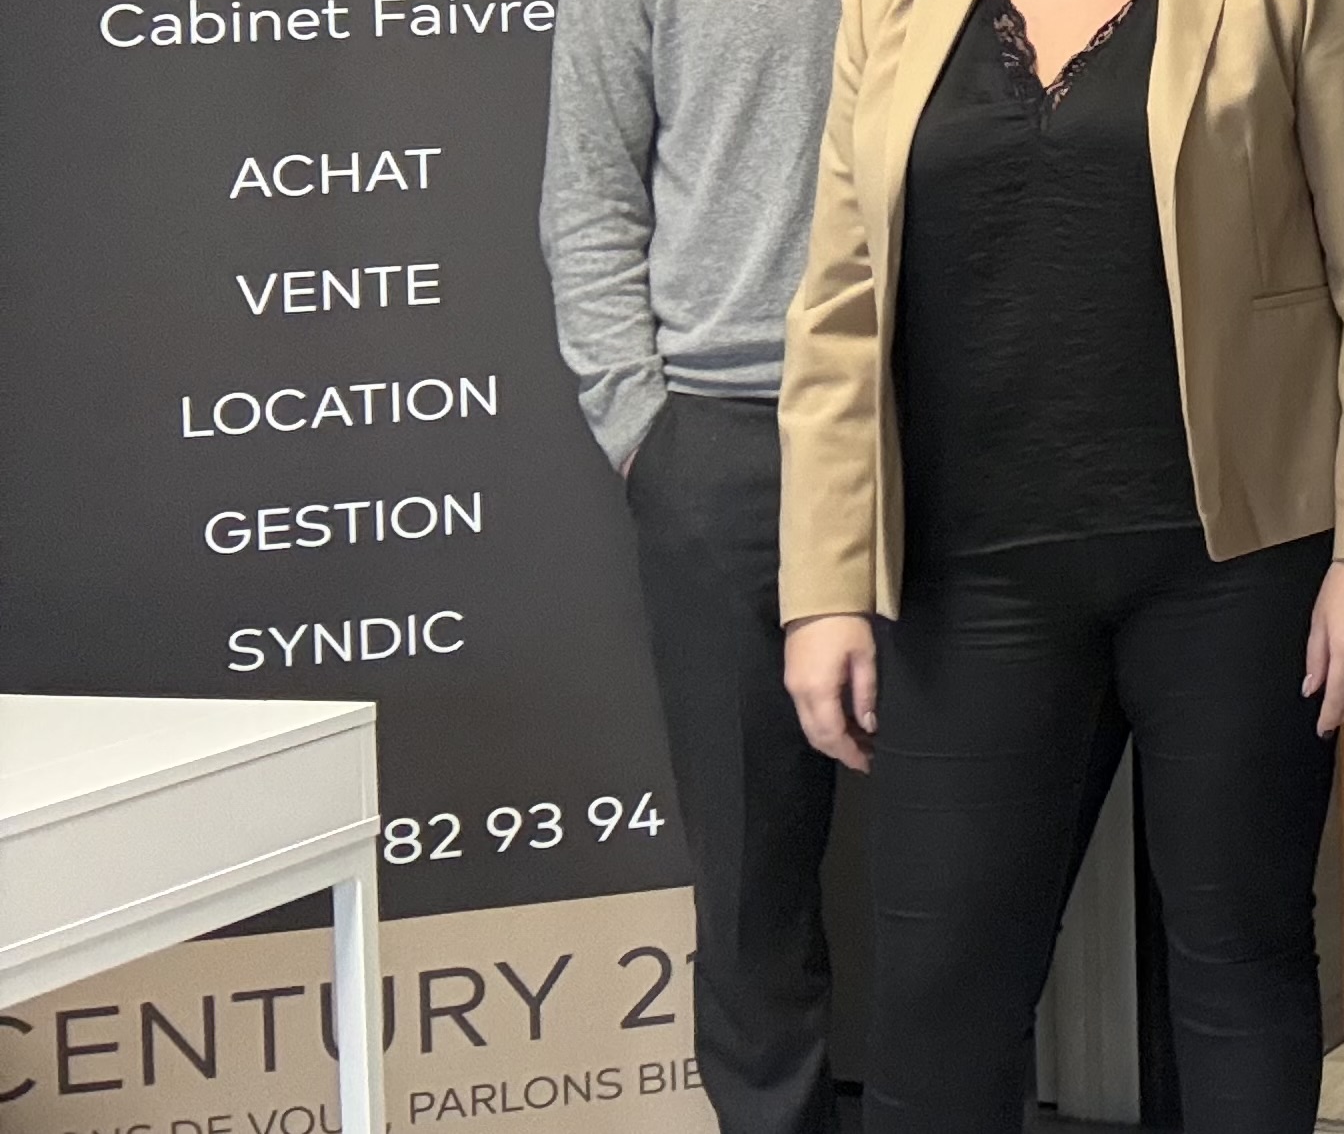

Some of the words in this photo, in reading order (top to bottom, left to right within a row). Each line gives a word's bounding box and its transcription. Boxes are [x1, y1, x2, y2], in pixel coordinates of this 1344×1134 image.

[230, 147, 442, 200] ACHAT
[236, 262, 442, 315] VENTE
[181, 374, 498, 439] LOCATION
[204, 491, 482, 555] GESTION
[227, 610, 465, 673] SYNDIC
[383, 812, 463, 865] 82
[486, 802, 564, 853] 93
[587, 791, 665, 843] 94
[617, 946, 698, 1030] 2
[410, 1067, 623, 1125] PARLONS
